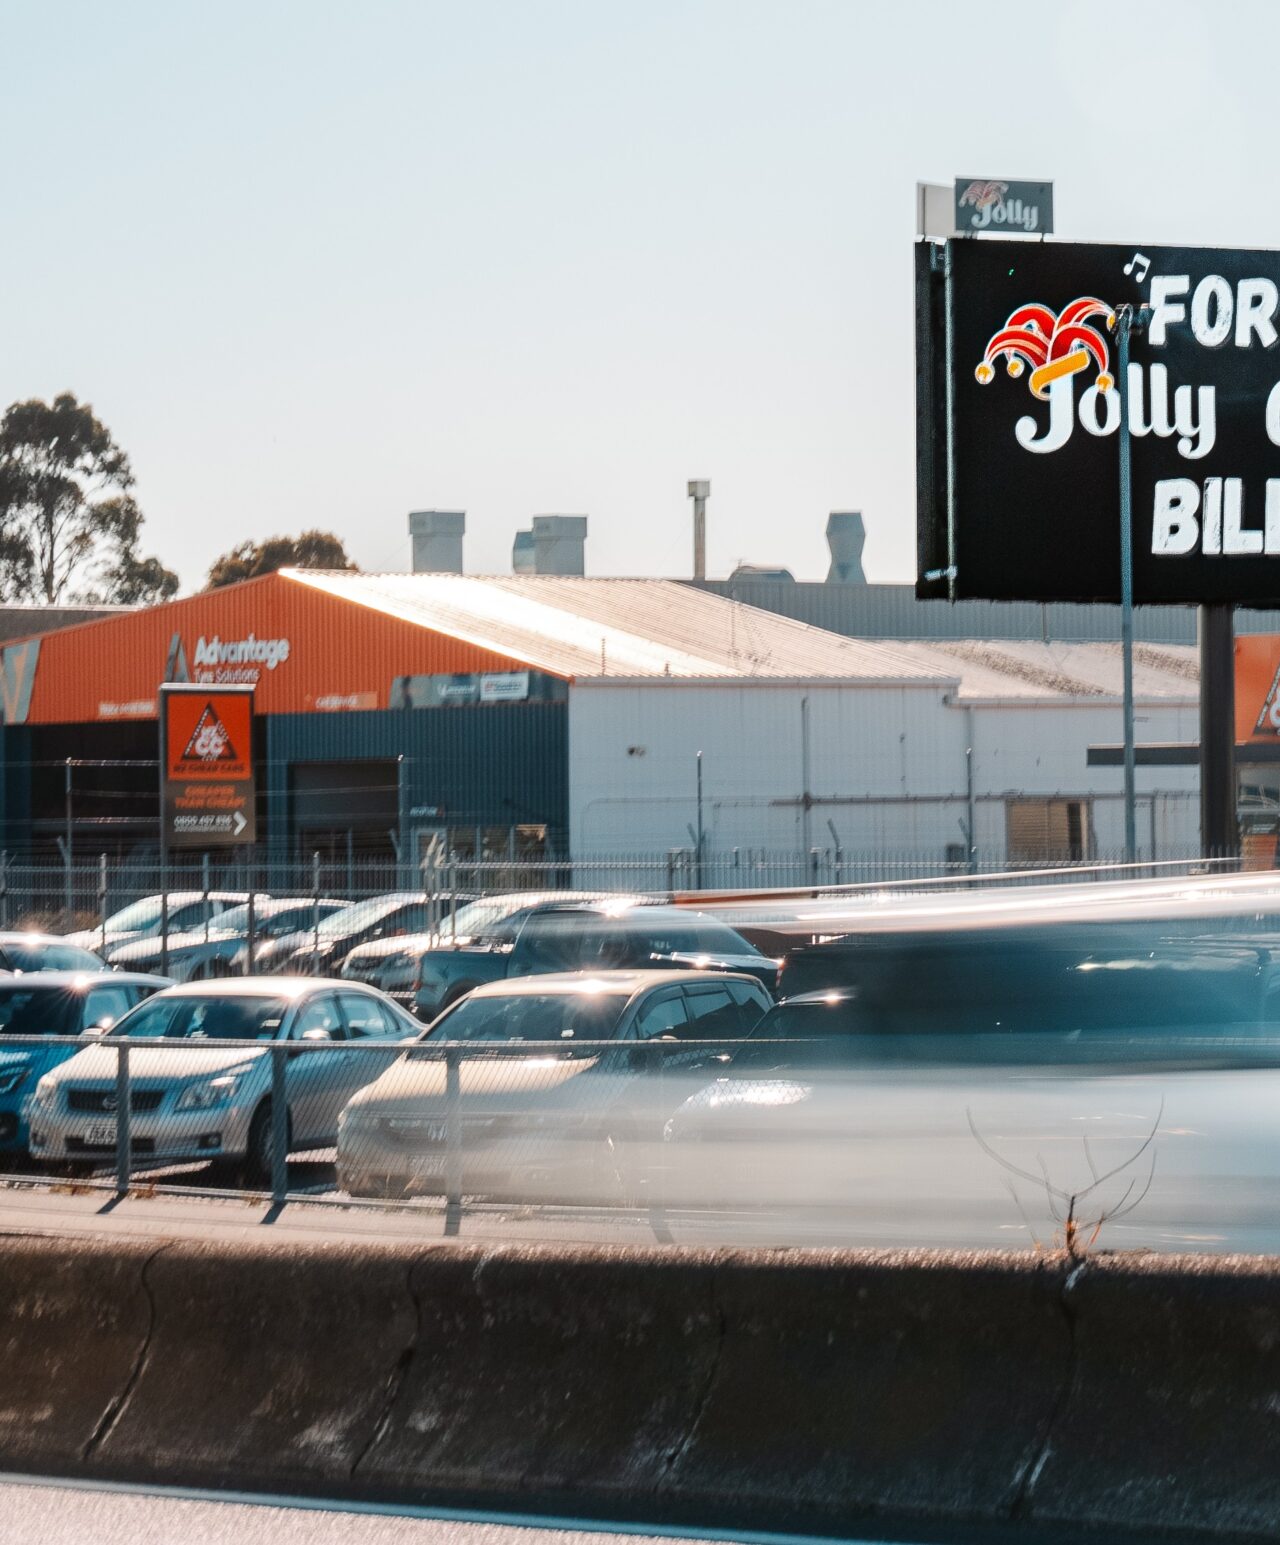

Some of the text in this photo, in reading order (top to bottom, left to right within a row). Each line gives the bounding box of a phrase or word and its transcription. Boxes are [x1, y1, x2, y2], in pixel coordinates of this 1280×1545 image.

[971, 198, 1038, 231] Jolly
[1148, 274, 1279, 348] FOR
[1015, 362, 1217, 460] Jolly
[194, 633, 290, 670] Advantage
